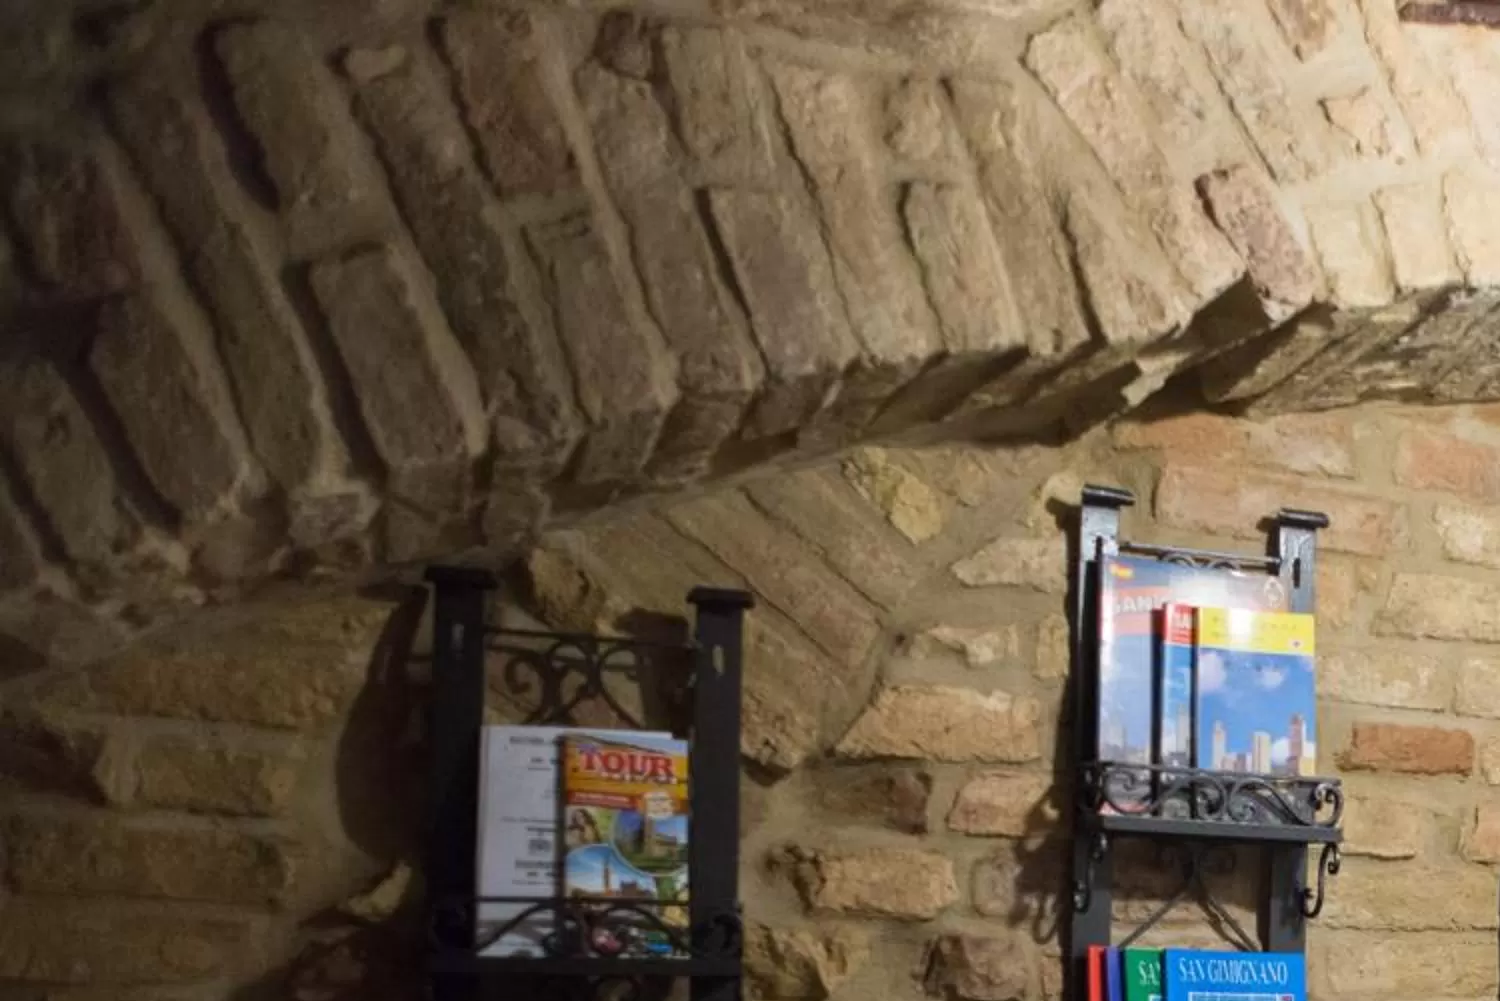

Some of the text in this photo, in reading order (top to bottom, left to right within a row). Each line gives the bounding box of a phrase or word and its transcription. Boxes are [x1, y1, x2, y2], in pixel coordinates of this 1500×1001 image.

[581, 750, 675, 777] TOUR
[1178, 957, 1288, 985] SAN GIMIGNANO
